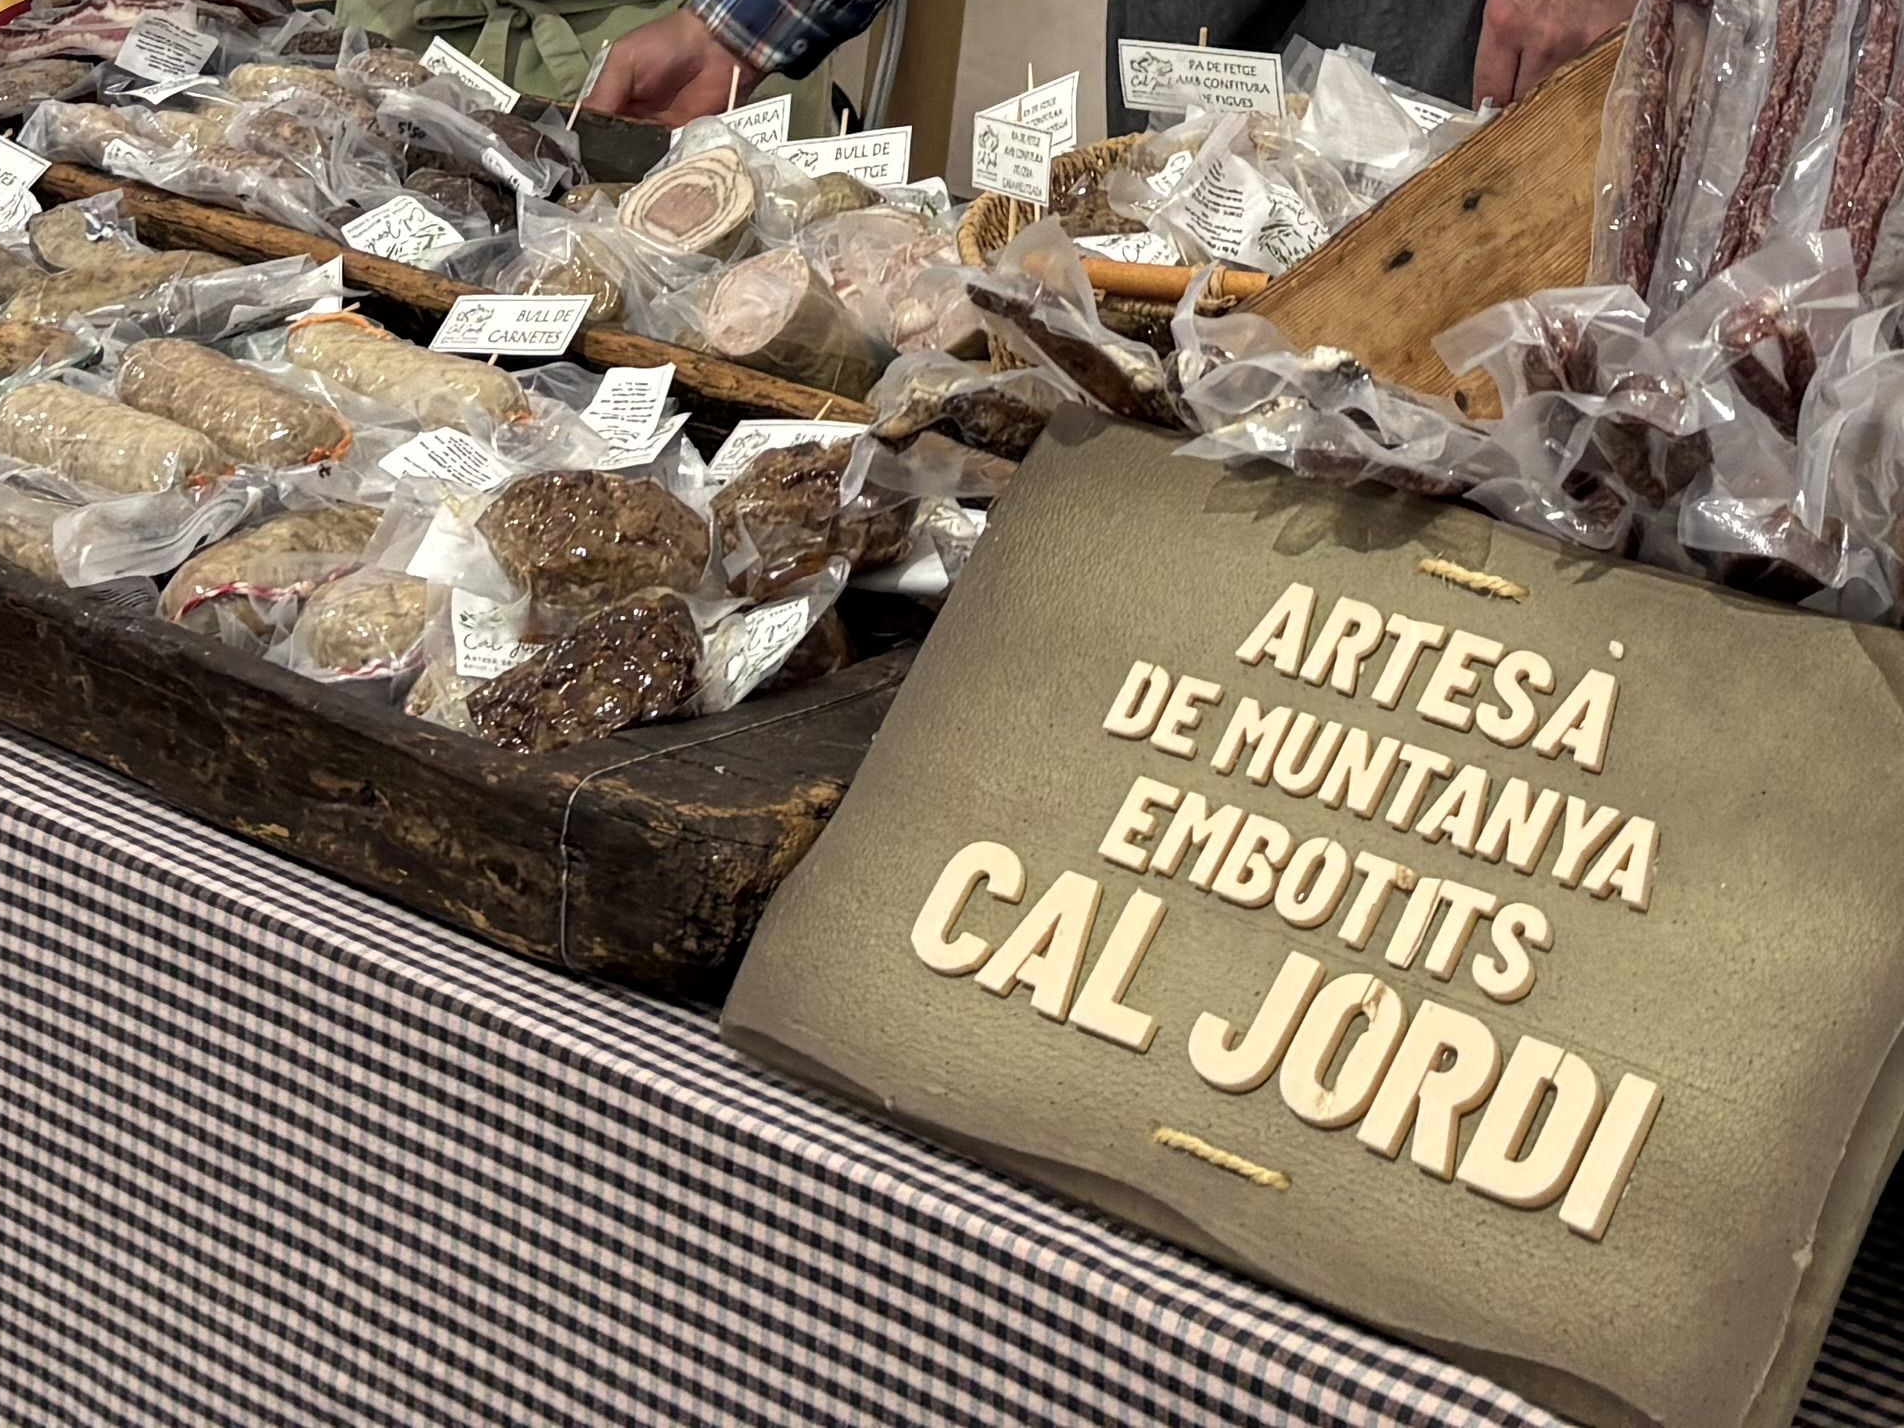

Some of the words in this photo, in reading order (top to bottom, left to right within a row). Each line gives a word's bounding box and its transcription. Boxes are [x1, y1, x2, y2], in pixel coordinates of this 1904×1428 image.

[1189, 60, 1204, 71] PA
[1207, 61, 1221, 72] DE
[1224, 62, 1257, 77] FETGE
[1204, 76, 1270, 95] CONFITURA
[1216, 95, 1253, 108] FIGUES
[835, 144, 868, 161] BULL
[873, 141, 890, 155] DE
[516, 310, 549, 322] BULL
[553, 309, 575, 322] DE
[488, 329, 563, 344] CARNETES
[1235, 579, 1629, 774] ARTESÀ
[1101, 659, 1223, 759] DE
[1209, 694, 1662, 914] MUNTANYA
[1097, 774, 1556, 1004] EMBOTITS
[909, 839, 1169, 1056] CAL
[1187, 949, 1665, 1242] JORDI
